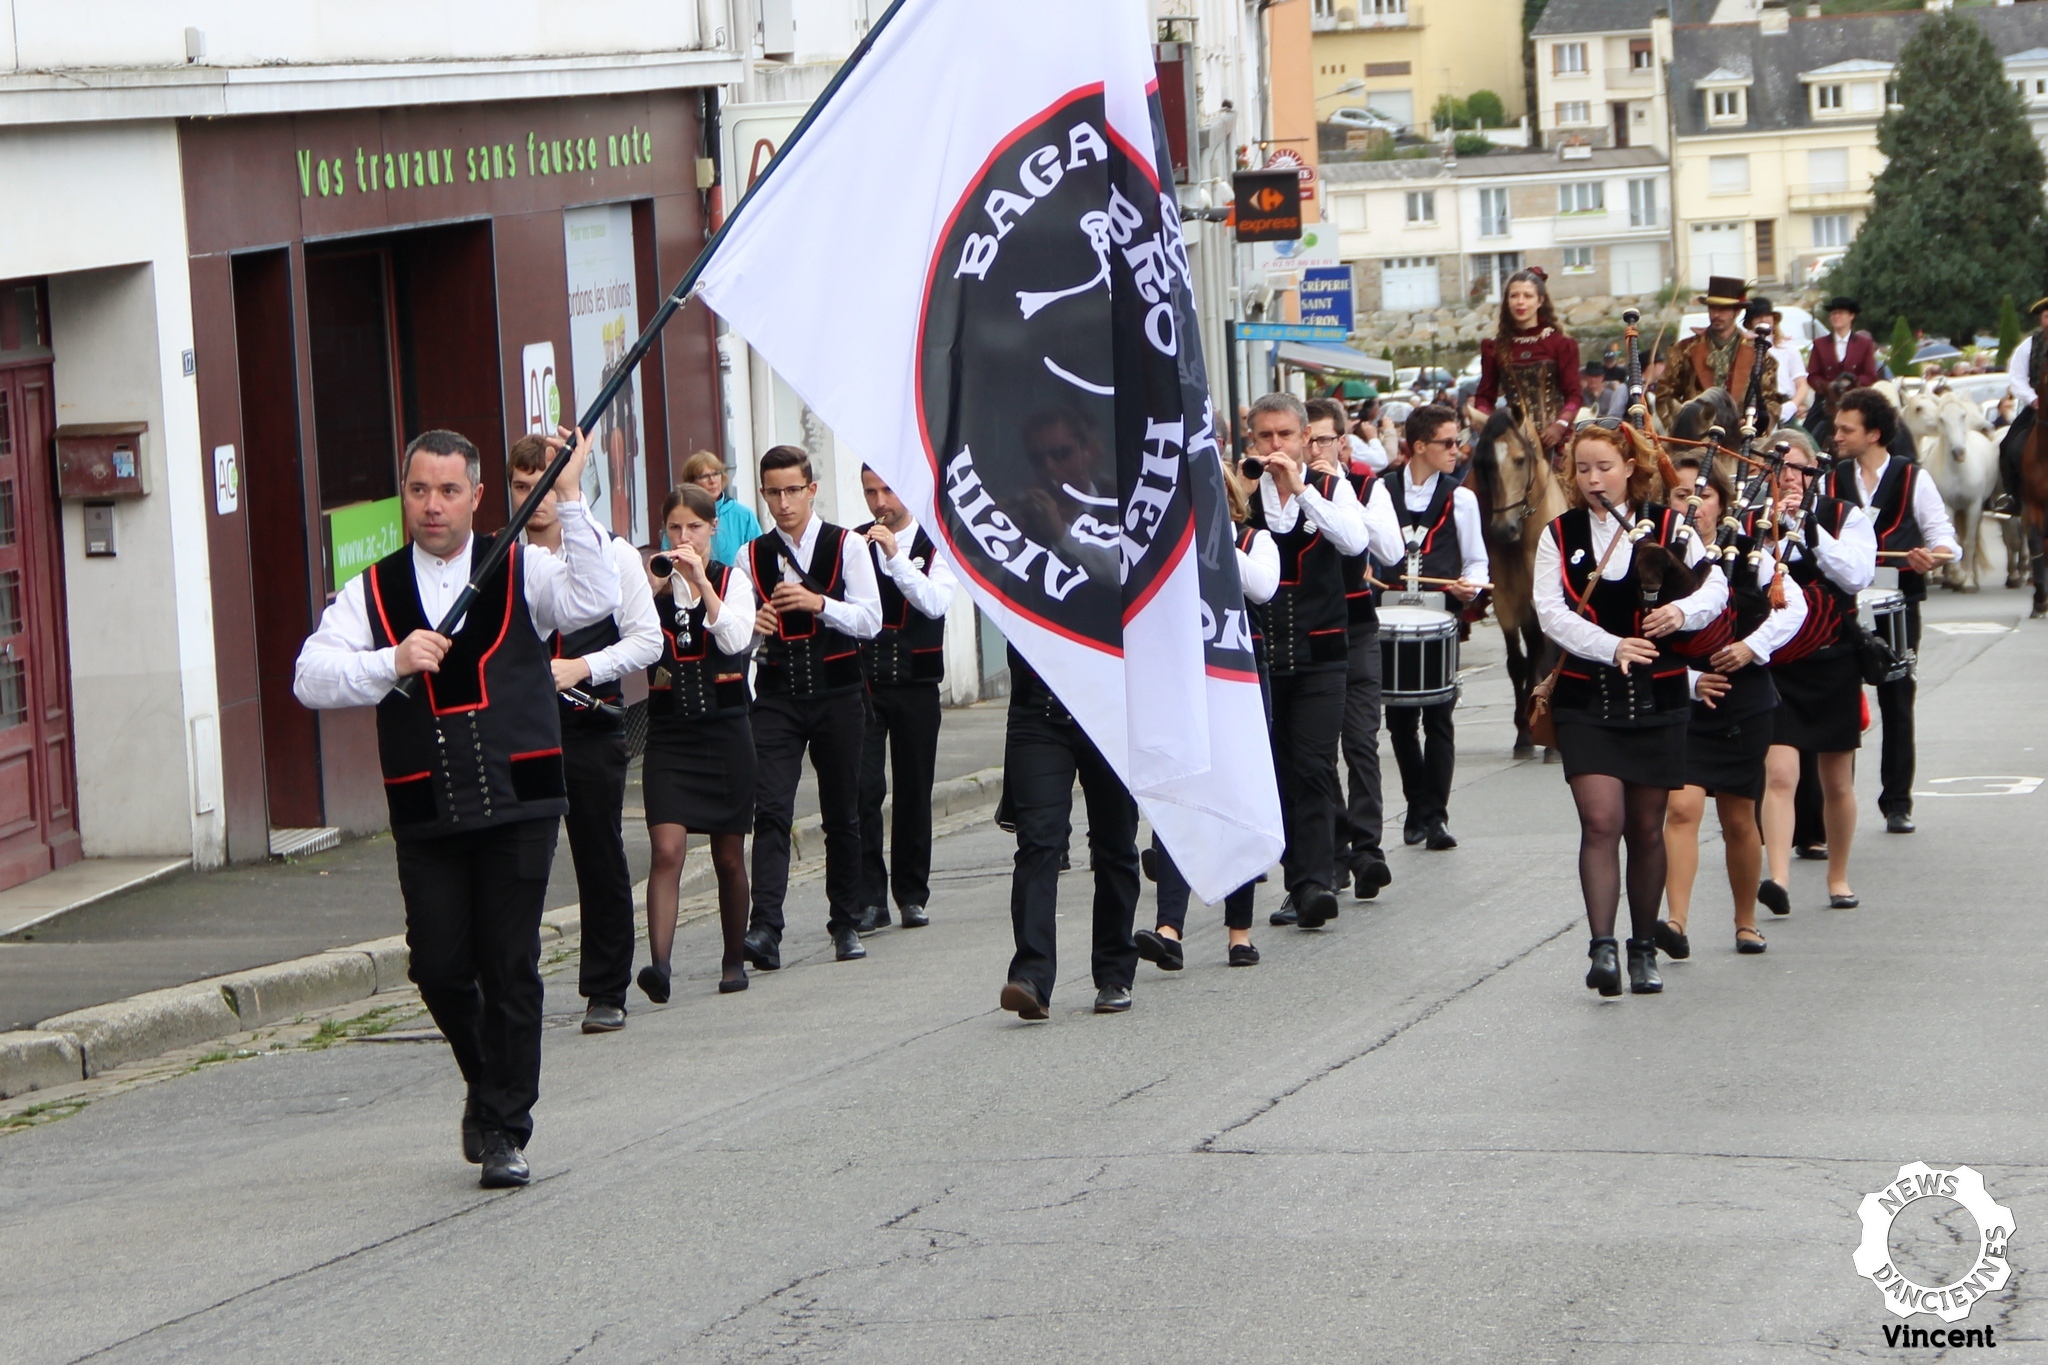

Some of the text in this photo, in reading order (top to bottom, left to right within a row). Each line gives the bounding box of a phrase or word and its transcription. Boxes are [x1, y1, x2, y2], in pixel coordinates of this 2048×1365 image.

[297, 125, 653, 198] Vos travaux sans fausse note
[1238, 216, 1299, 234] express
[594, 281, 605, 312] les
[607, 278, 632, 309] violons
[1301, 296, 1334, 310] SAINT
[184, 353, 192, 372] 17
[530, 367, 553, 435] AC
[218, 457, 236, 503] AC
[337, 520, 399, 569] www.ac-2.fr
